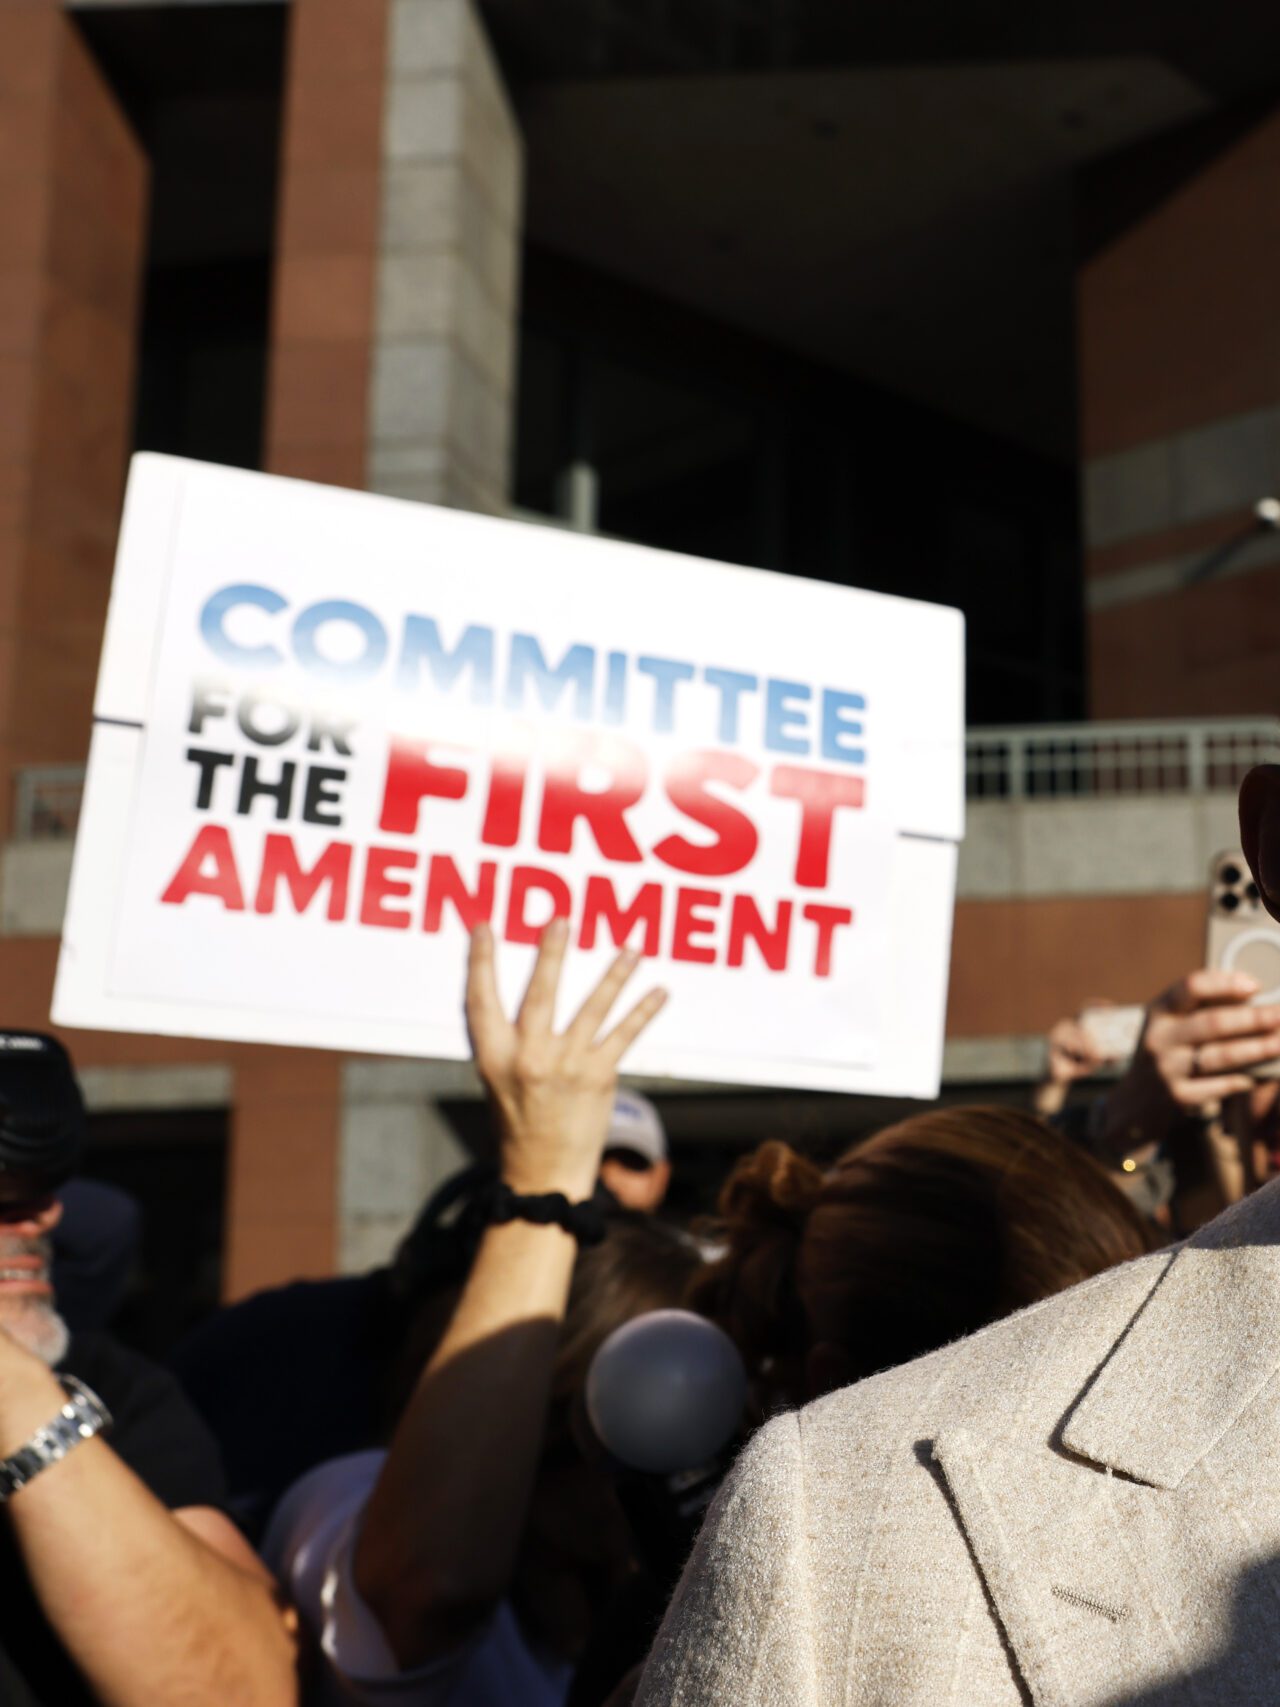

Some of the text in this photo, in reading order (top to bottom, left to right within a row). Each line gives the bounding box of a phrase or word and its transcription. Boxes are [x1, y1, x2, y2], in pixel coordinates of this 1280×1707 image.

[187, 677, 356, 757] FOR
[198, 582, 867, 765] COMMITTEE
[186, 747, 348, 827] THE
[378, 730, 868, 891] FIRST
[159, 823, 855, 979] AMENDMENT
